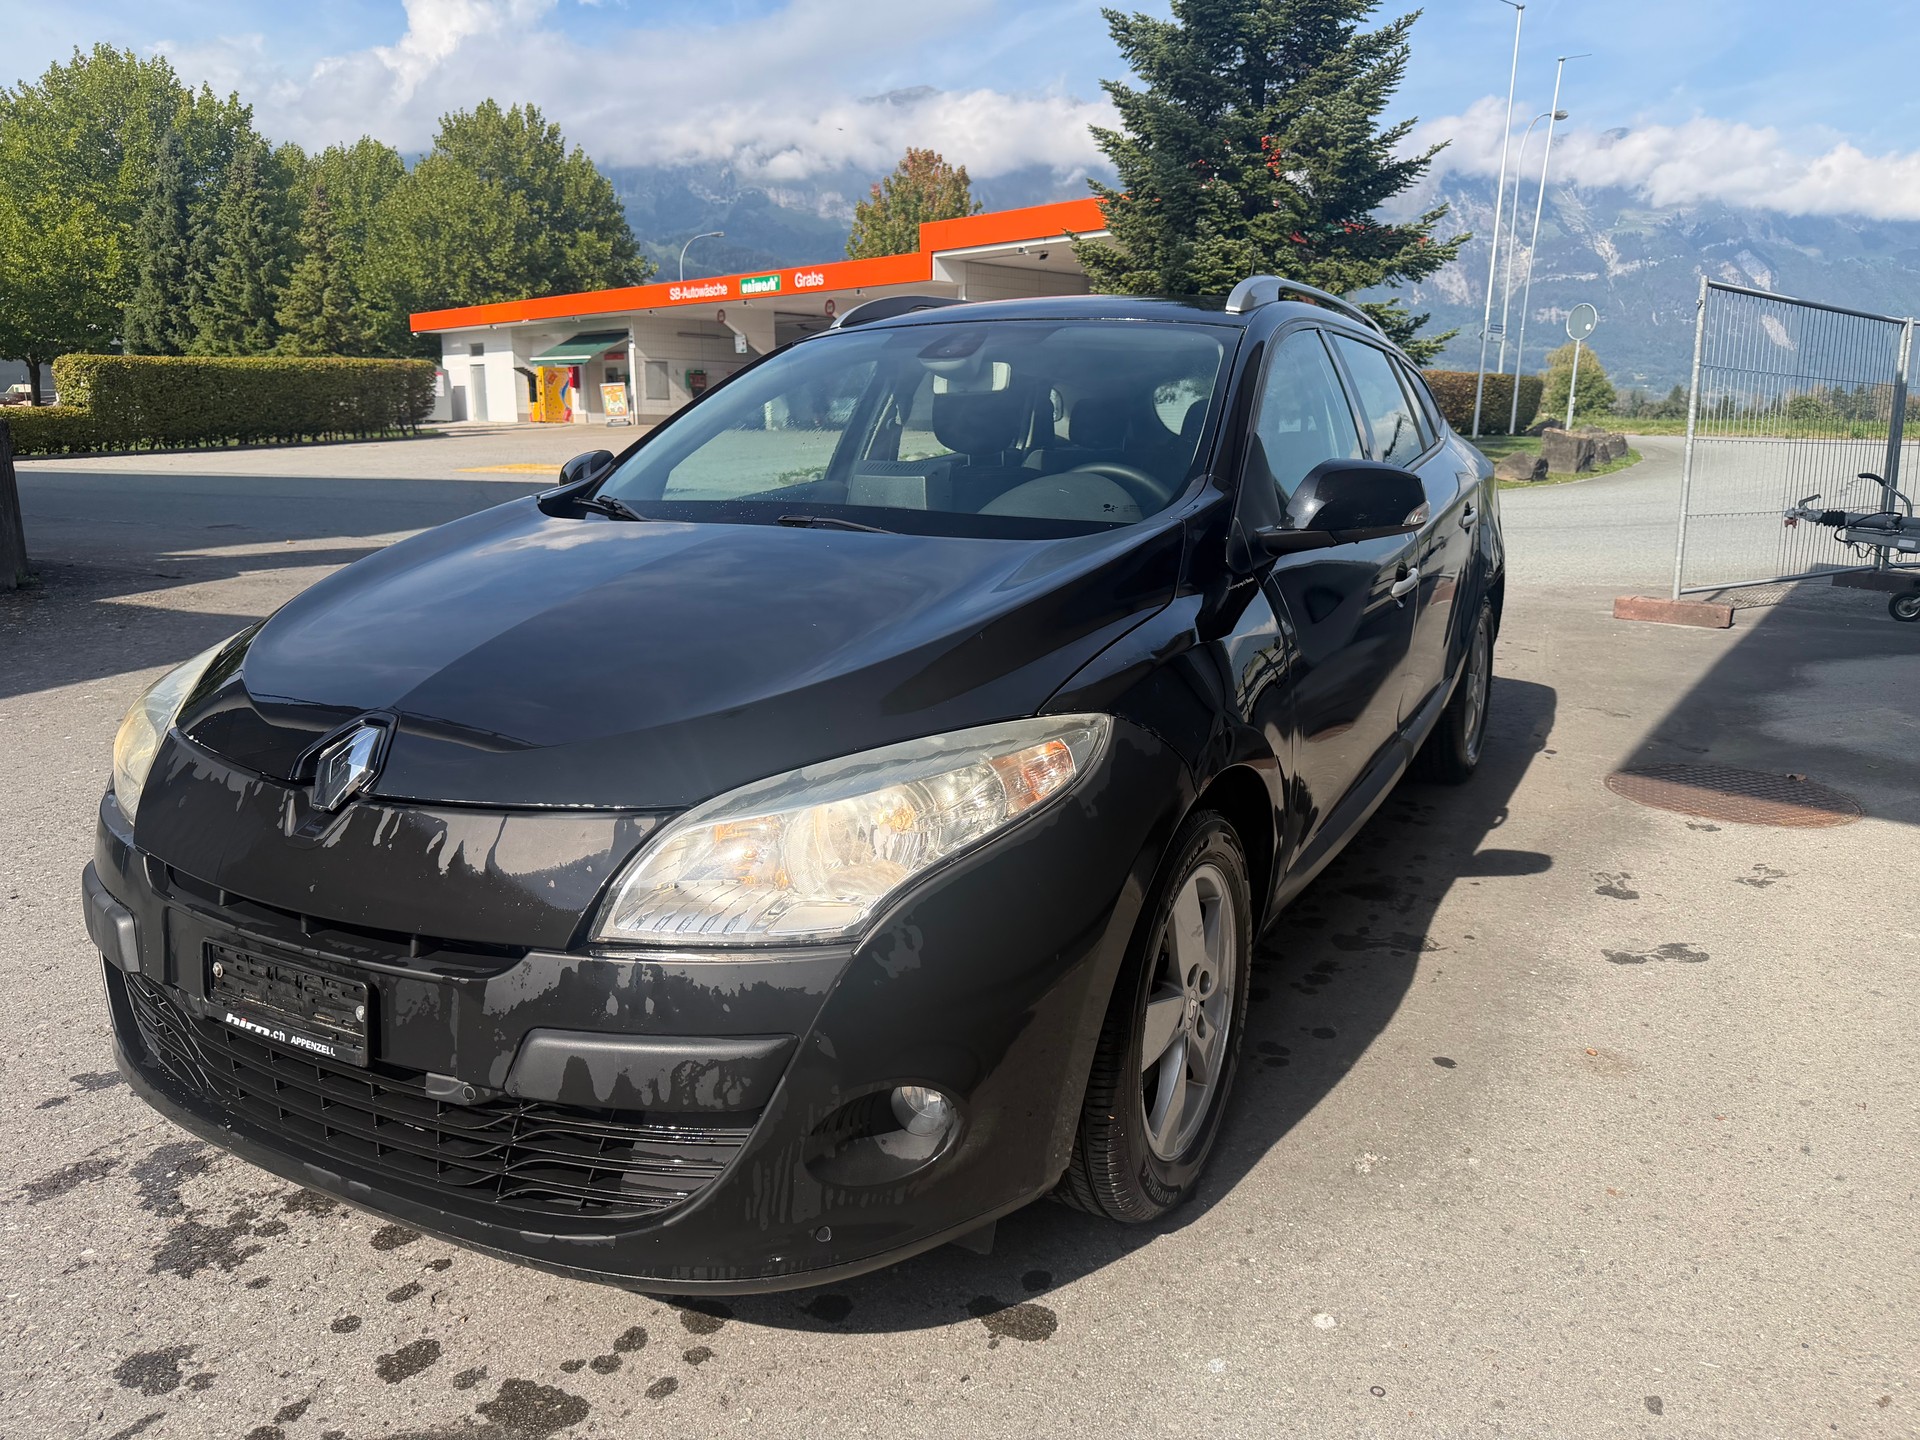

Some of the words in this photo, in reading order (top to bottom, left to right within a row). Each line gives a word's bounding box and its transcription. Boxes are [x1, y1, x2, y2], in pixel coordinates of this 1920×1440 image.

[669, 283, 728, 301] SB-Autowäsche
[794, 271, 824, 288] Grabs
[290, 1035, 336, 1056] APPENZELL
